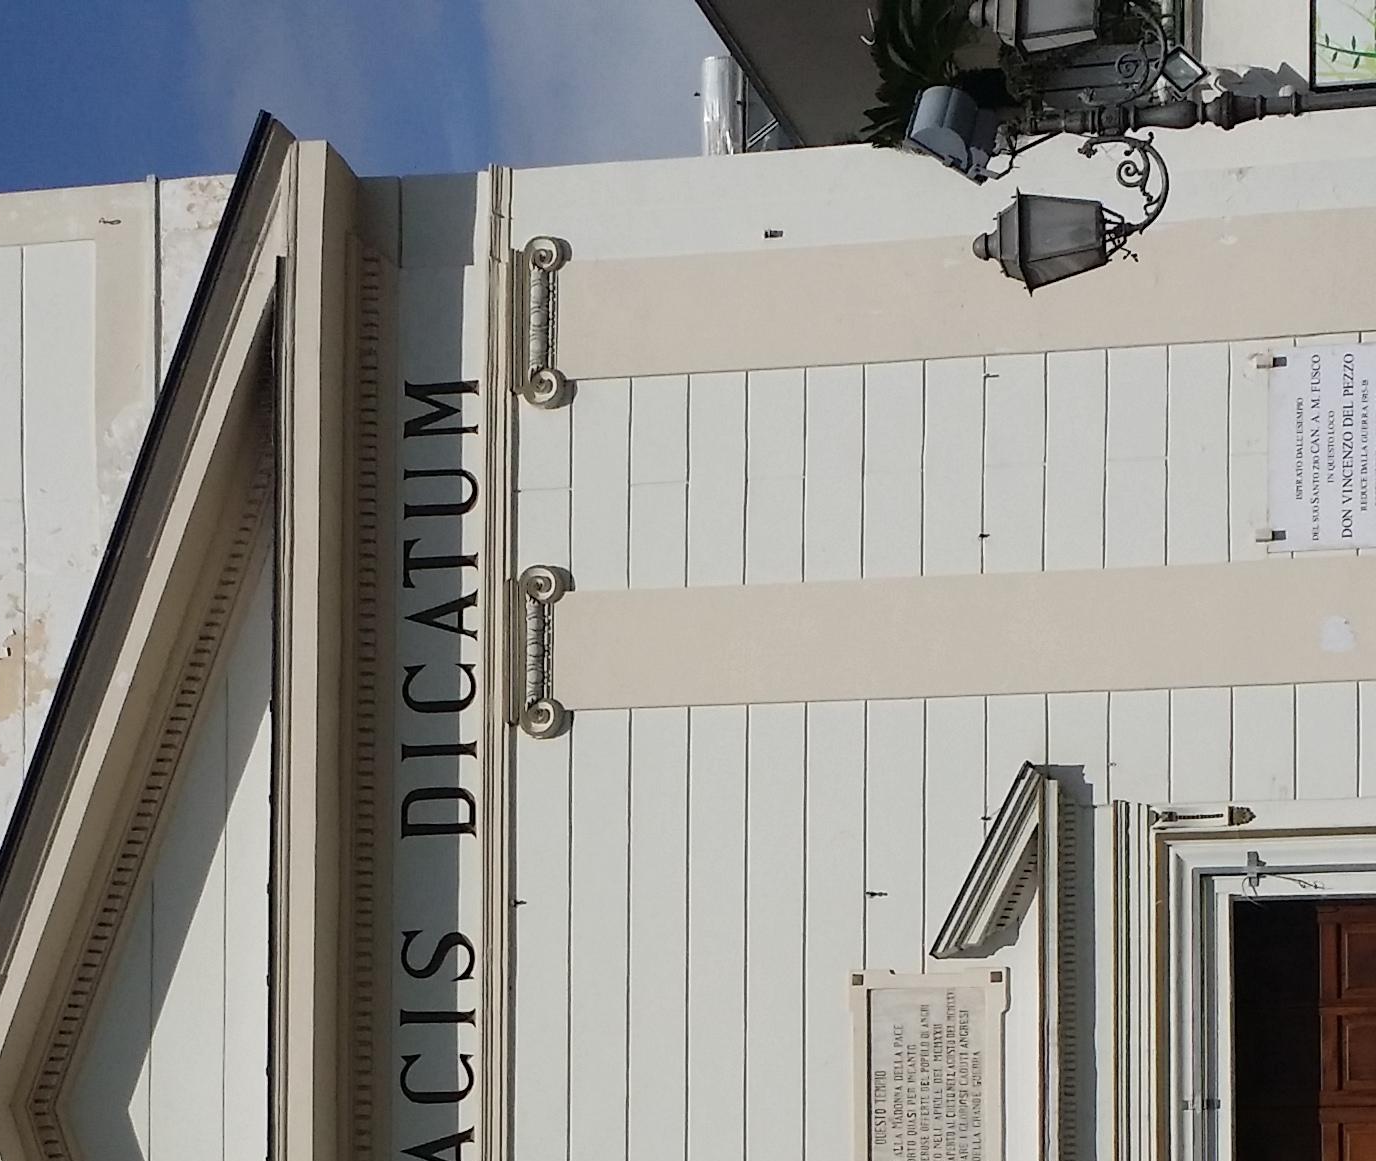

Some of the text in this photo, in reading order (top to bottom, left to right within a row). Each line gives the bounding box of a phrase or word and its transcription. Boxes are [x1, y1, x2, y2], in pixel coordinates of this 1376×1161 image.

[1311, 354, 1320, 392] FUSCO
[1342, 354, 1354, 538] DON VINCENZO DEL PEZZO
[1360, 446, 1368, 474] DALLA
[1312, 456, 1320, 470] ZIO
[1310, 472, 1320, 504] SANTO
[1328, 474, 1335, 483] IN
[1312, 506, 1320, 522] SUO
[1312, 524, 1320, 540] DEL
[400, 379, 481, 840] DICATUM
[893, 1024, 904, 1047] PACE
[893, 1051, 904, 1080] DELLA
